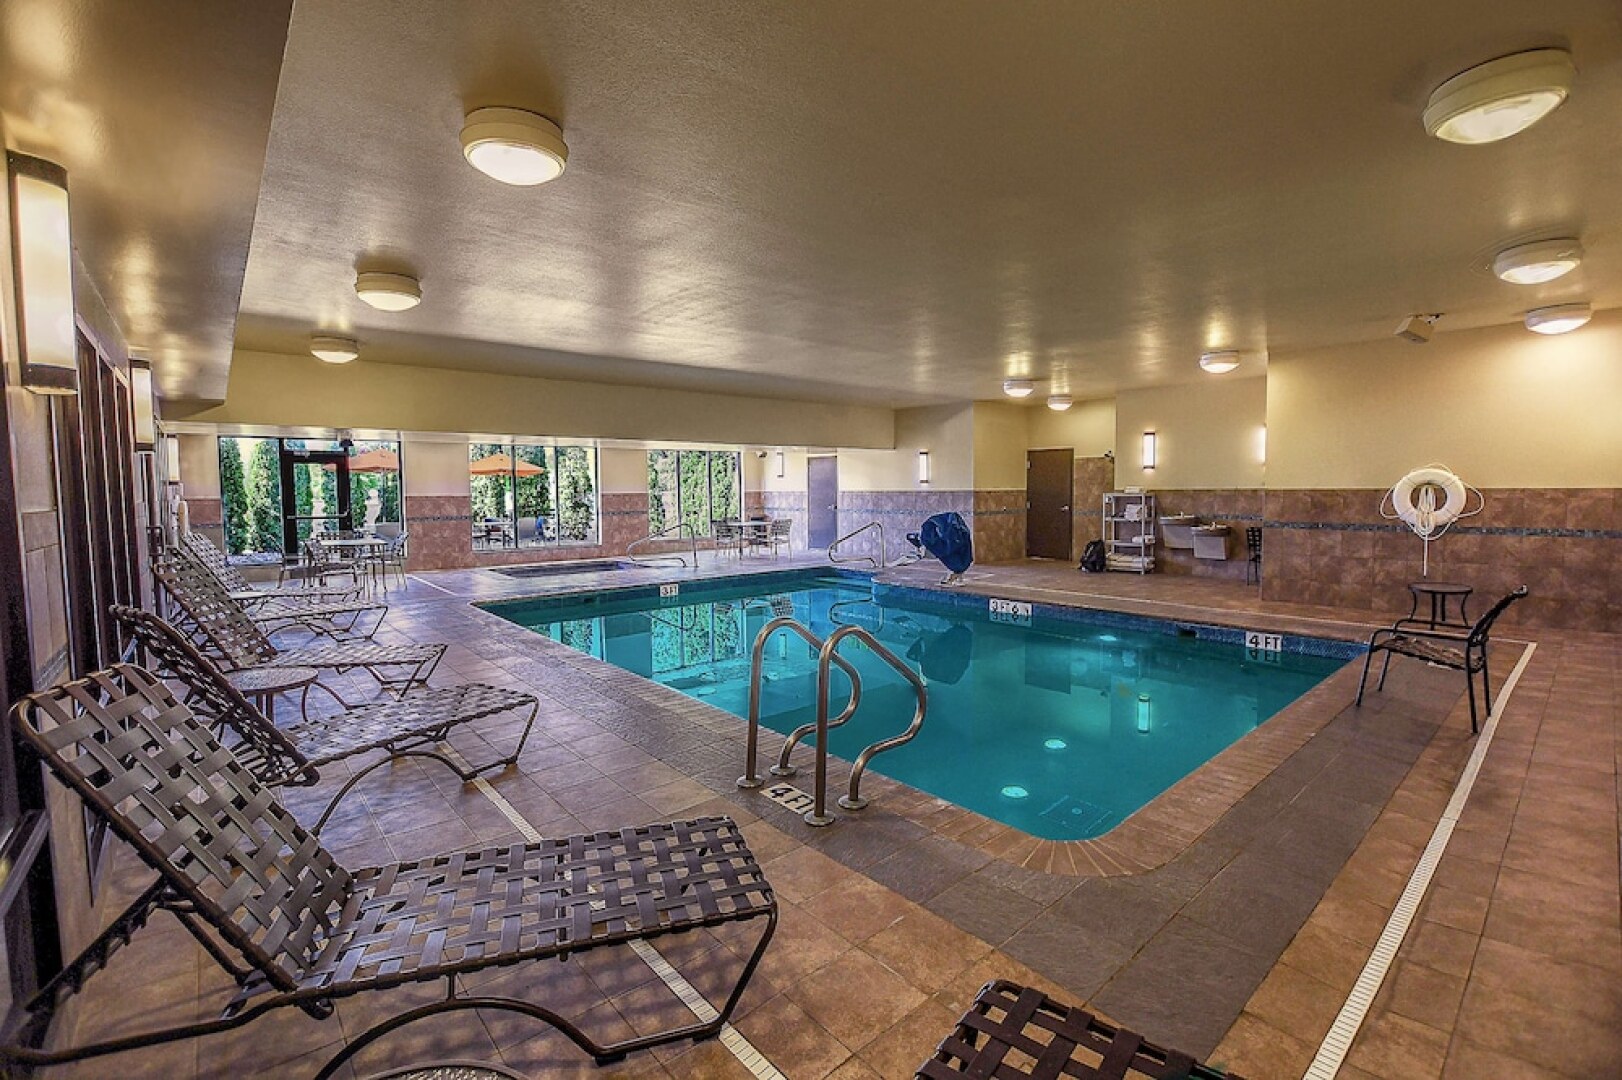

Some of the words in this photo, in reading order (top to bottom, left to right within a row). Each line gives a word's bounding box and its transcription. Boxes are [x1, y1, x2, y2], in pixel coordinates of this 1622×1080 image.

[992, 600, 998, 611] 3
[1249, 635, 1260, 648] 4
[1264, 636, 1280, 649] FT
[769, 787, 795, 799] 4
